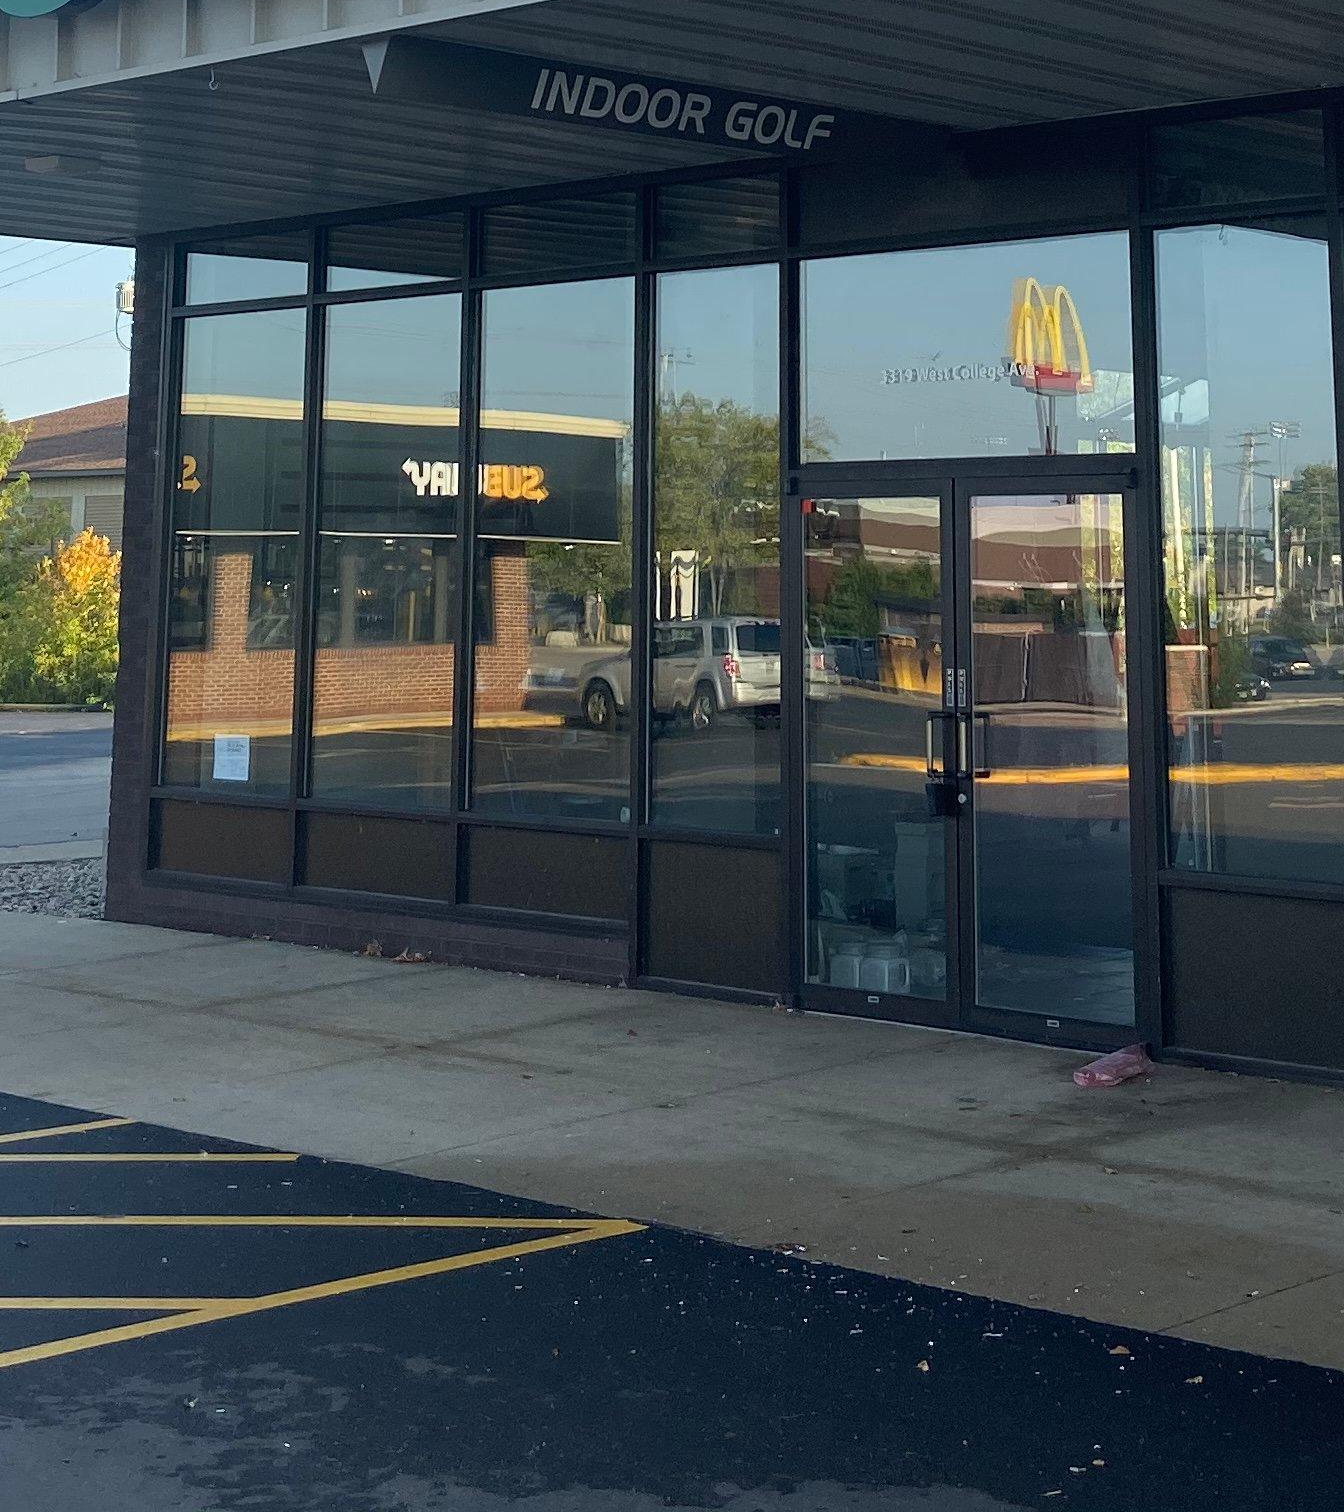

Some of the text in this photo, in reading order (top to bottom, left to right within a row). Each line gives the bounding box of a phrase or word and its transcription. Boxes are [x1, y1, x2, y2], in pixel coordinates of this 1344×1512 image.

[531, 68, 835, 150] INDOOR GOLF
[917, 365, 951, 382] West
[952, 363, 1005, 382] College
